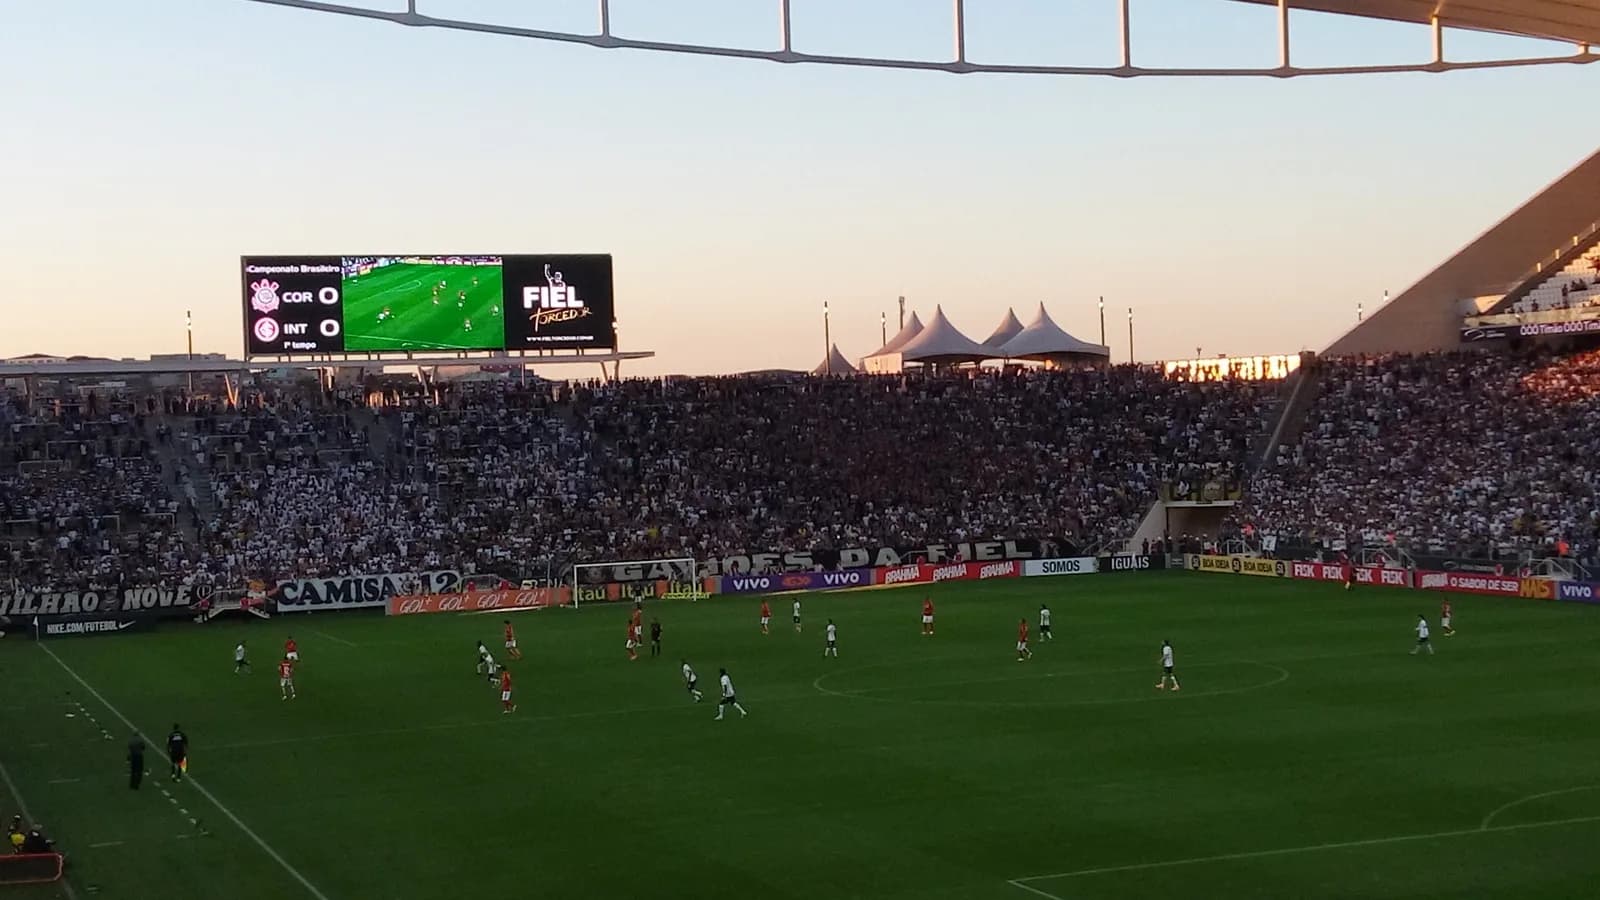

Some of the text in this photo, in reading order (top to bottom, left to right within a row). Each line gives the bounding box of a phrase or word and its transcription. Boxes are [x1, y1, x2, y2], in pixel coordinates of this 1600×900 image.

[248, 265, 340, 274] Campeonato Brasileiro
[282, 286, 339, 305] COR 0
[523, 286, 584, 308] FIEL
[284, 319, 340, 337] INT 0
[839, 548, 901, 568] DA
[1042, 560, 1080, 573] SOMOS
[1111, 557, 1150, 569] IGUAIS
[733, 578, 770, 590] VIVO
[823, 573, 860, 584] VIVO
[885, 561, 1014, 584] BRAHMA BRAHMA BRAHMA
[1294, 563, 1315, 577] FISK
[1321, 565, 1343, 579] FISK
[1380, 569, 1404, 585] FISK
[122, 584, 192, 610] NOVE
[279, 576, 397, 605] CAMISA
[1450, 577, 1458, 587] O
[1459, 578, 1487, 589] SABOR
[1488, 580, 1500, 590] DE
[1501, 580, 1519, 592] SER
[1520, 580, 1550, 599] MAIS
[1562, 584, 1592, 597] VIVO
[47, 620, 118, 634] NIKE.COM/FUTEBOL
